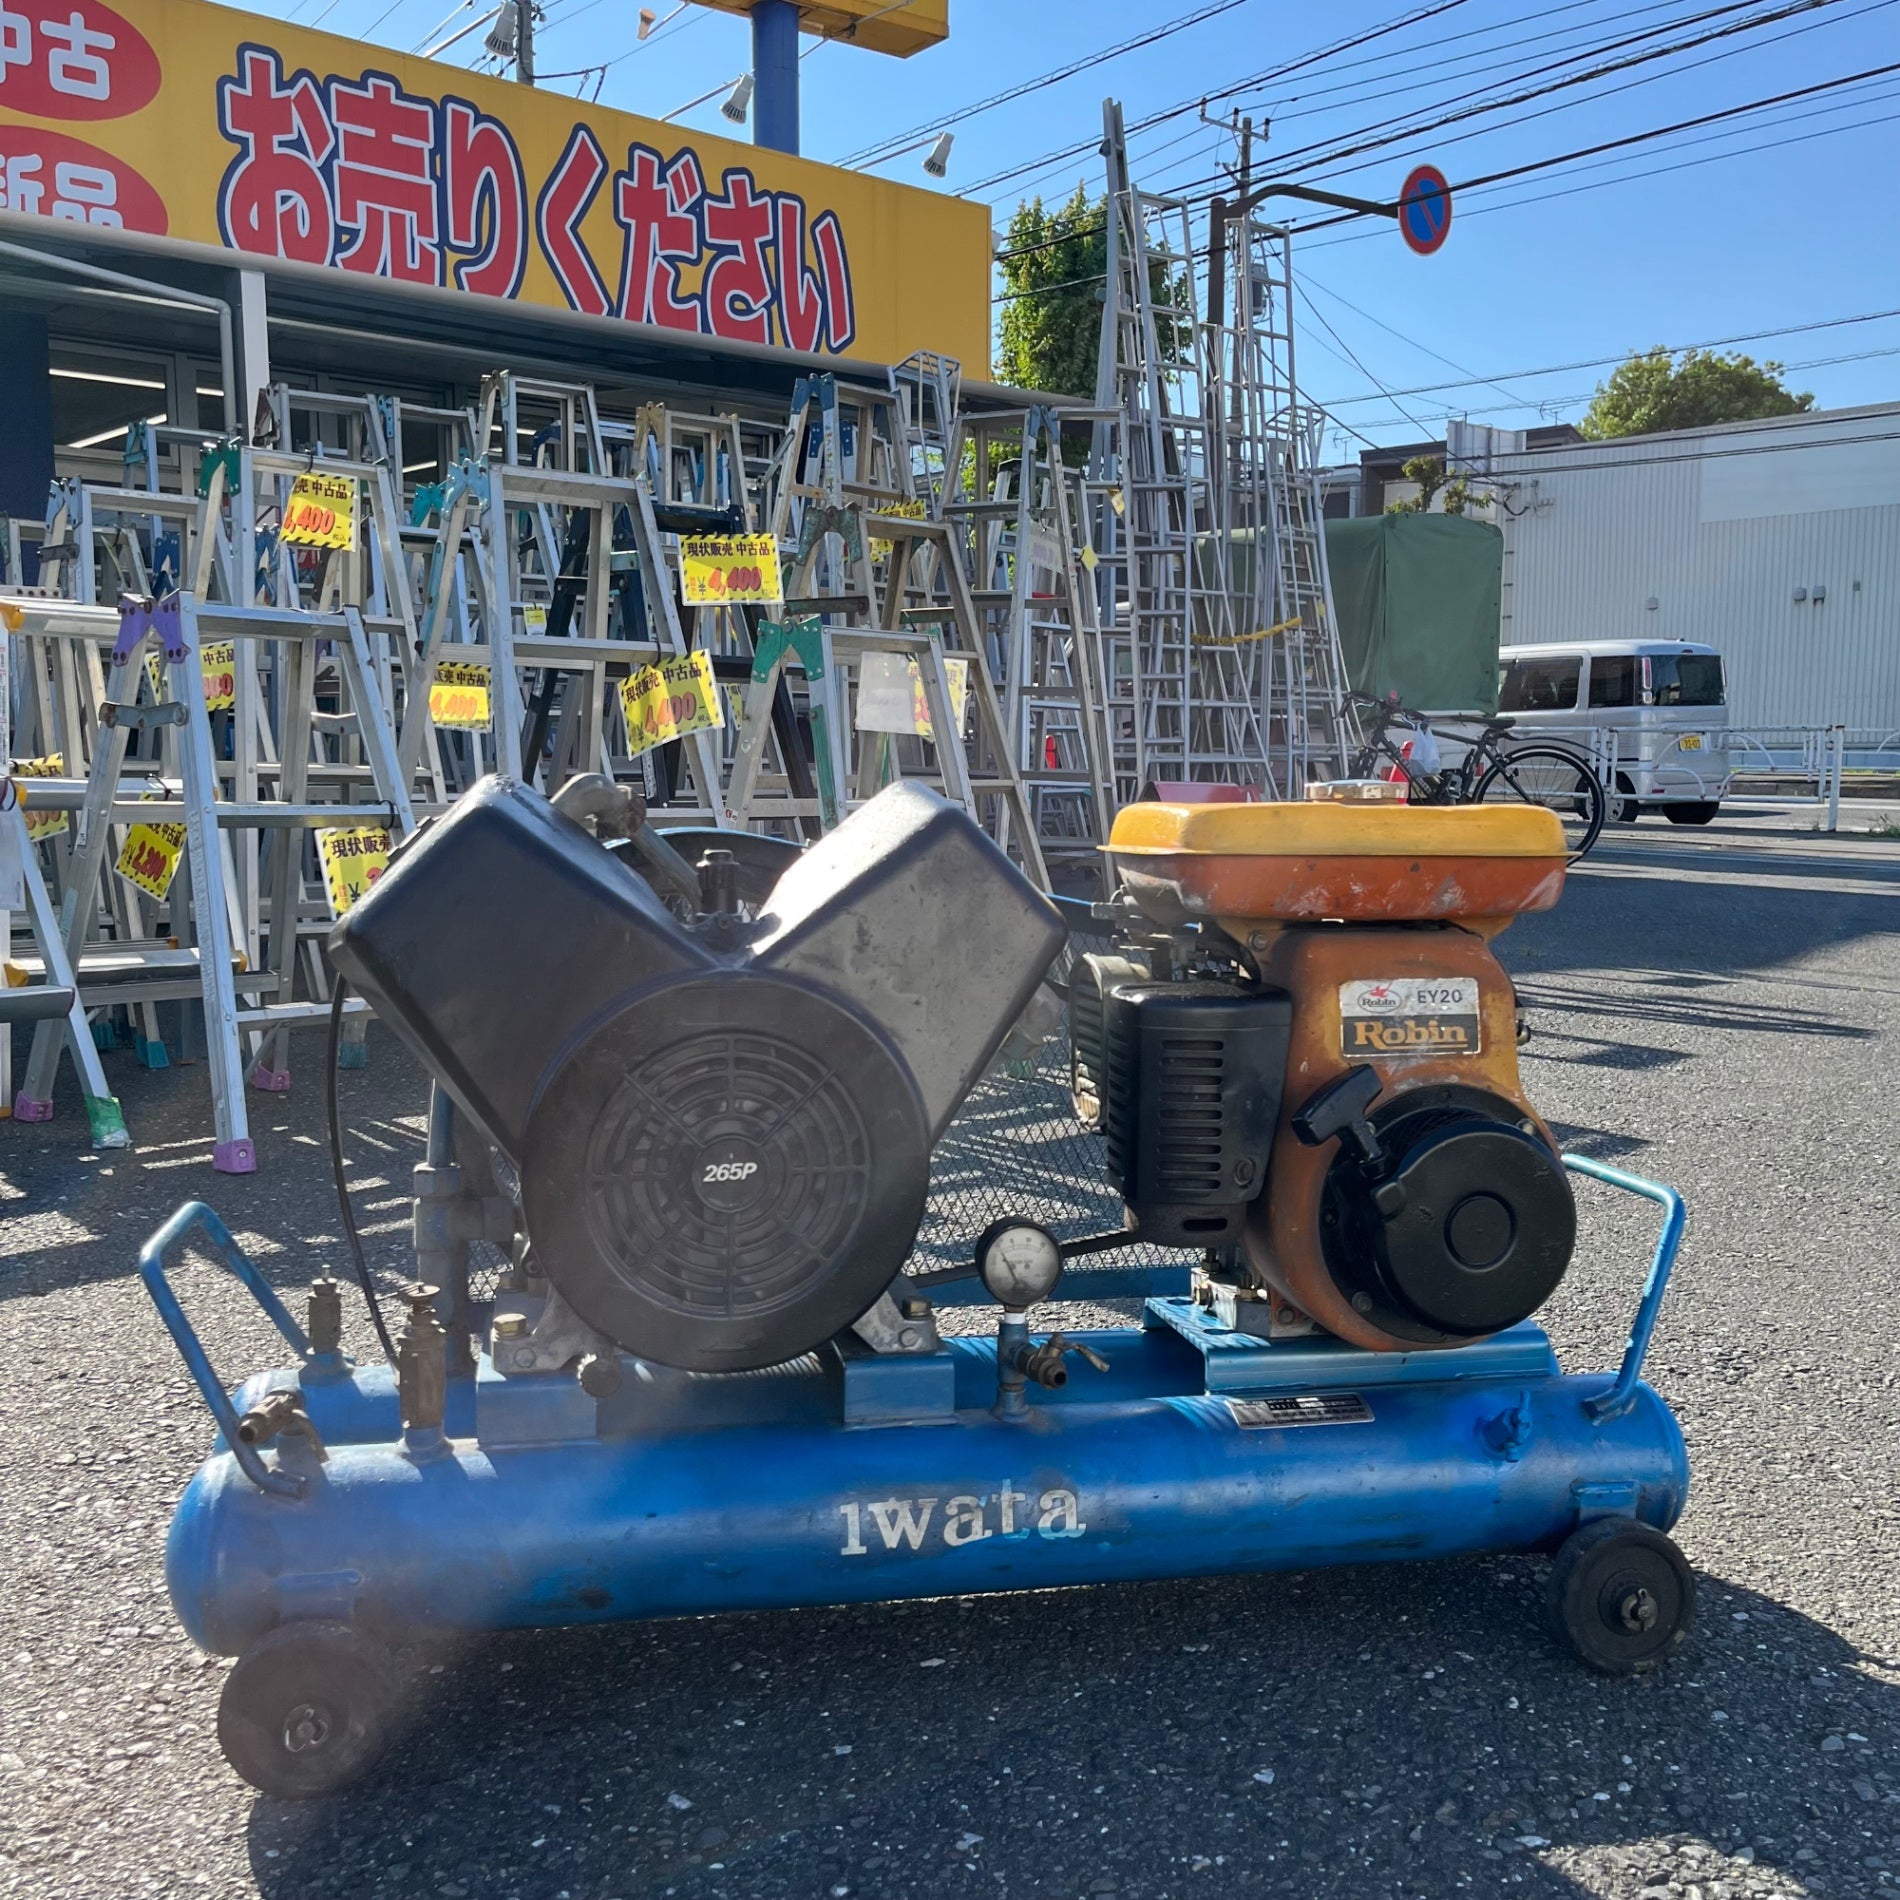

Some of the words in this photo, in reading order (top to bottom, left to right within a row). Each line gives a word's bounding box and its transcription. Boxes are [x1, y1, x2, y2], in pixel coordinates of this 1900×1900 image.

[217, 42, 856, 354] お売りください
[312, 480, 347, 500] 中古品
[737, 542, 770, 556] 中古品
[457, 670, 486, 688] 中古品
[663, 662, 702, 684] 中古品
[1361, 998, 1397, 1008] Robin
[1417, 989, 1463, 1004] EY20
[1353, 1019, 1469, 1050] Robin
[703, 1162, 758, 1183] 265P
